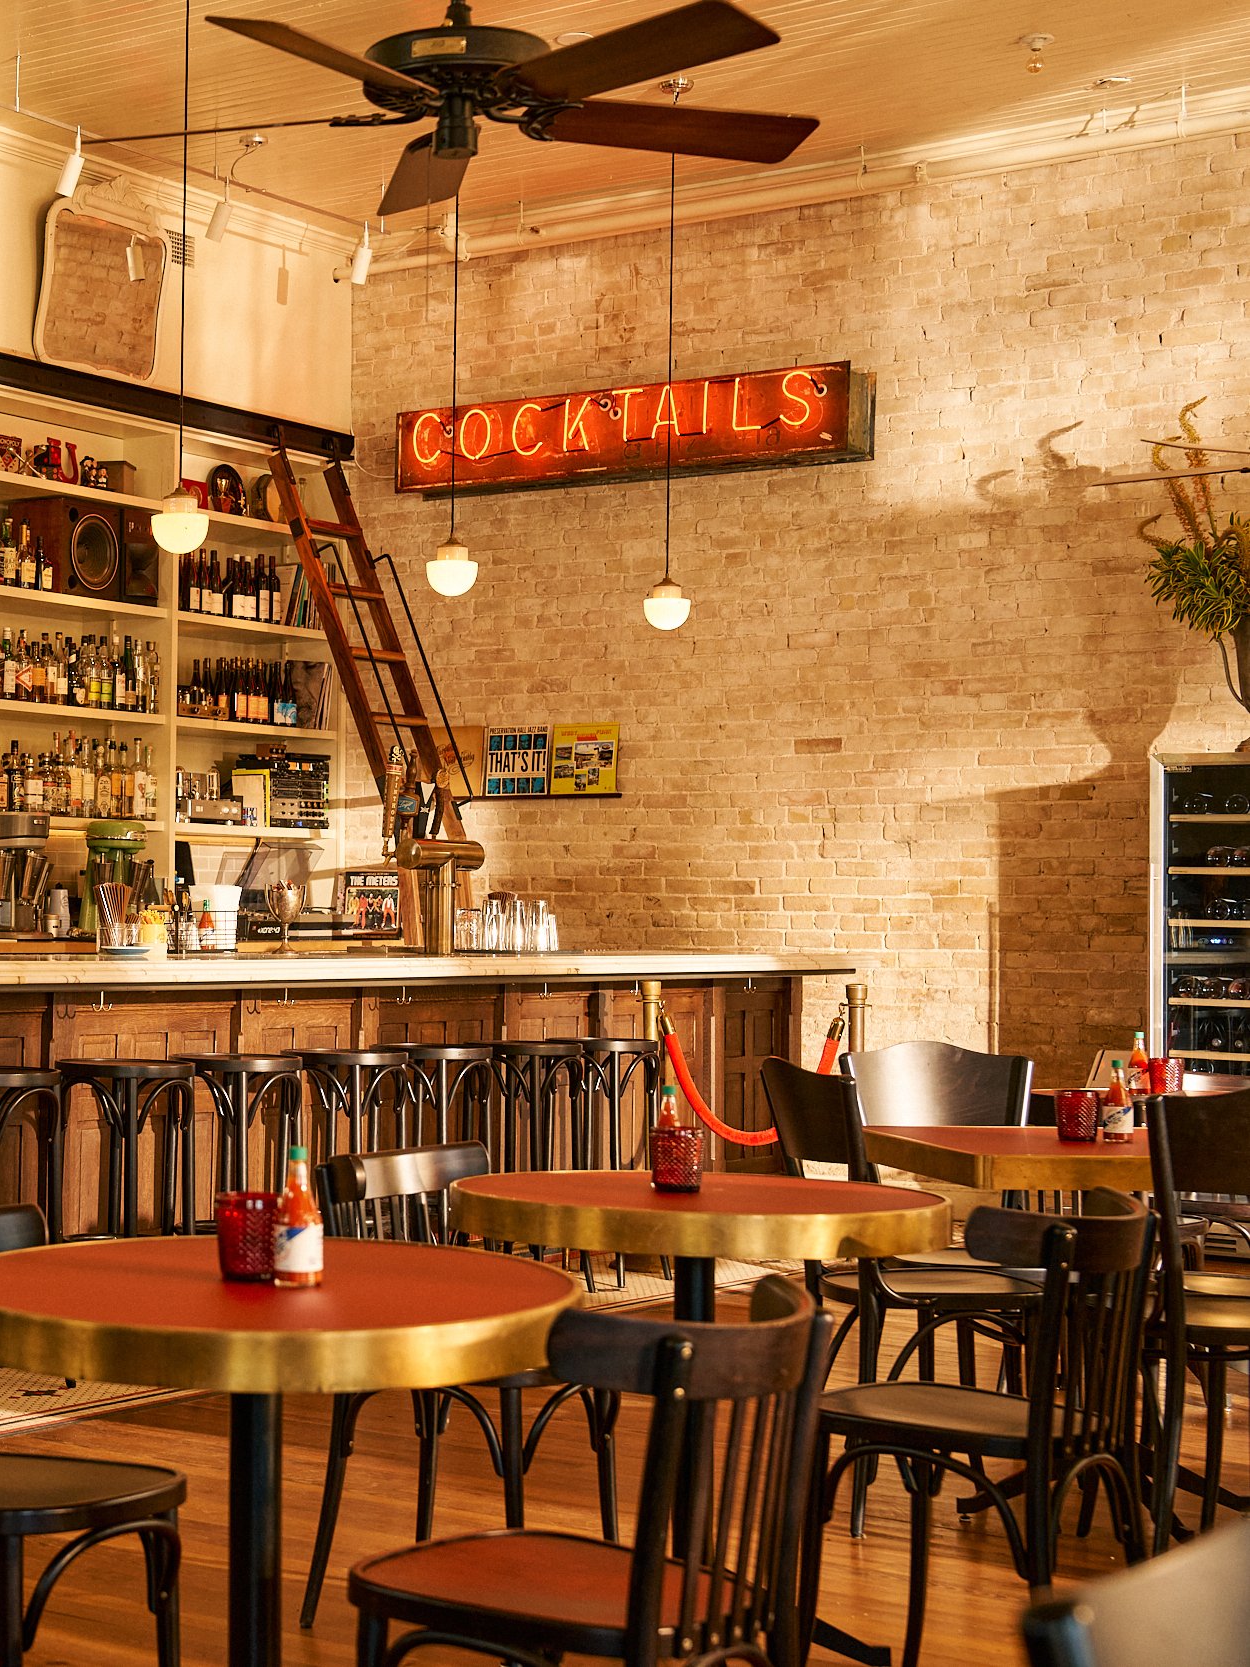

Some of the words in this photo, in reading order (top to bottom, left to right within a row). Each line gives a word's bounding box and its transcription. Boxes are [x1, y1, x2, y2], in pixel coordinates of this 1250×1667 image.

[413, 371, 814, 464] COCKTAILS
[489, 751, 528, 772] THAT'S
[532, 751, 546, 772] IT!
[350, 876, 364, 886] THE
[366, 876, 399, 886] METERS
